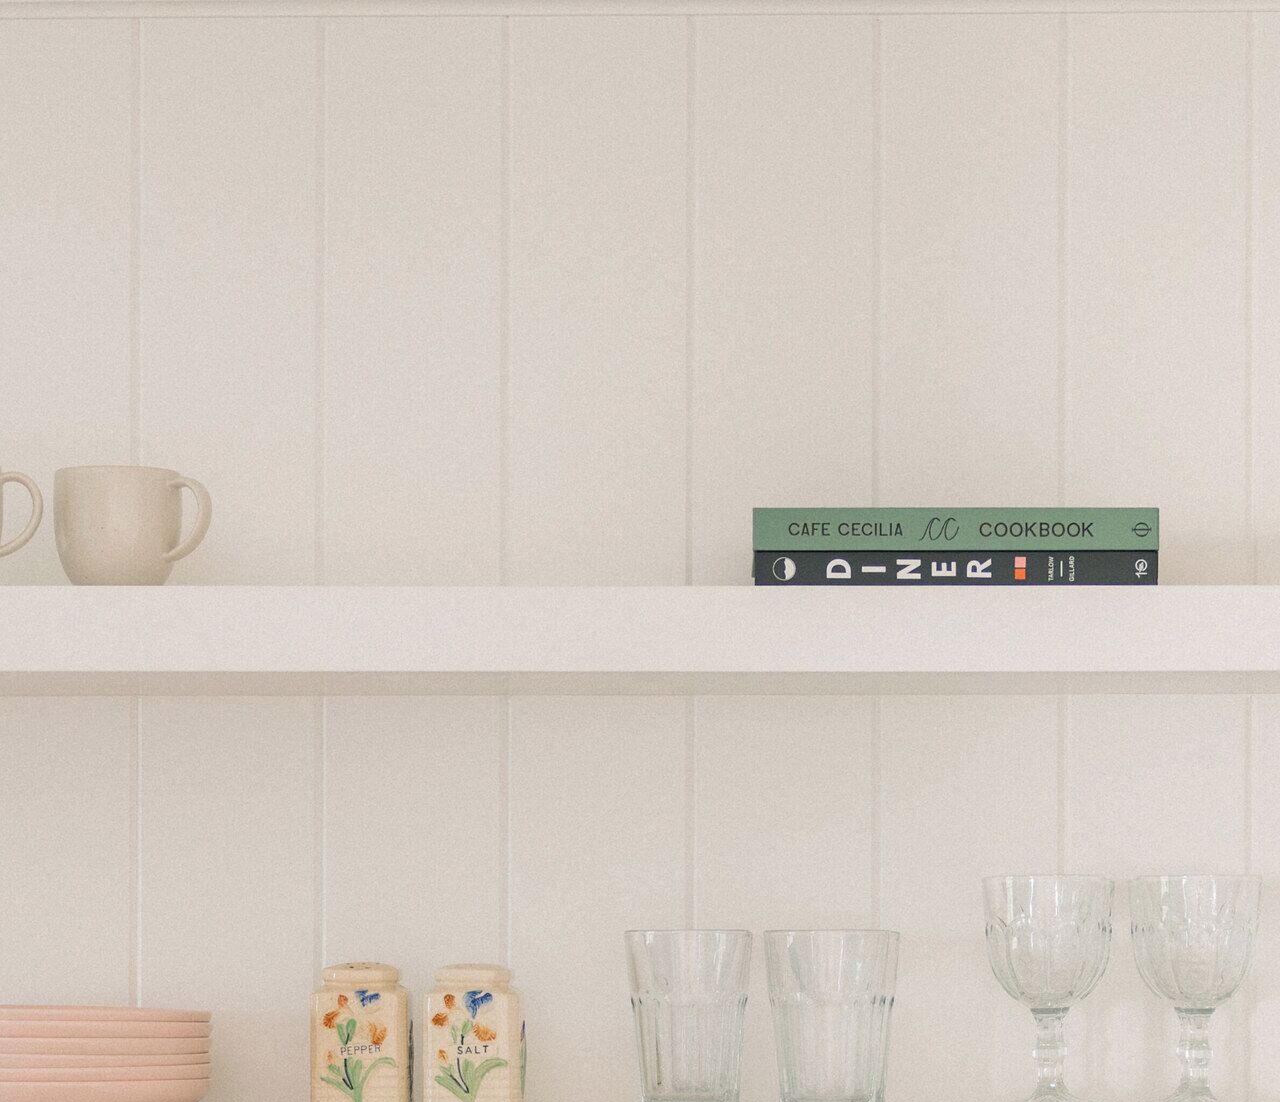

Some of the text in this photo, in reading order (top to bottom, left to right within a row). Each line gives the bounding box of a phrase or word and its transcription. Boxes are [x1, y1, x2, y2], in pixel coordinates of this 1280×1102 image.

[788, 522, 831, 537] CAFE
[838, 522, 904, 537] CECILIA
[979, 522, 1094, 538] COOKBOOK
[825, 558, 993, 580] DINER
[1047, 555, 1055, 582] TARLOW
[340, 1043, 382, 1056] PEPPER
[456, 1044, 489, 1055] SALT
